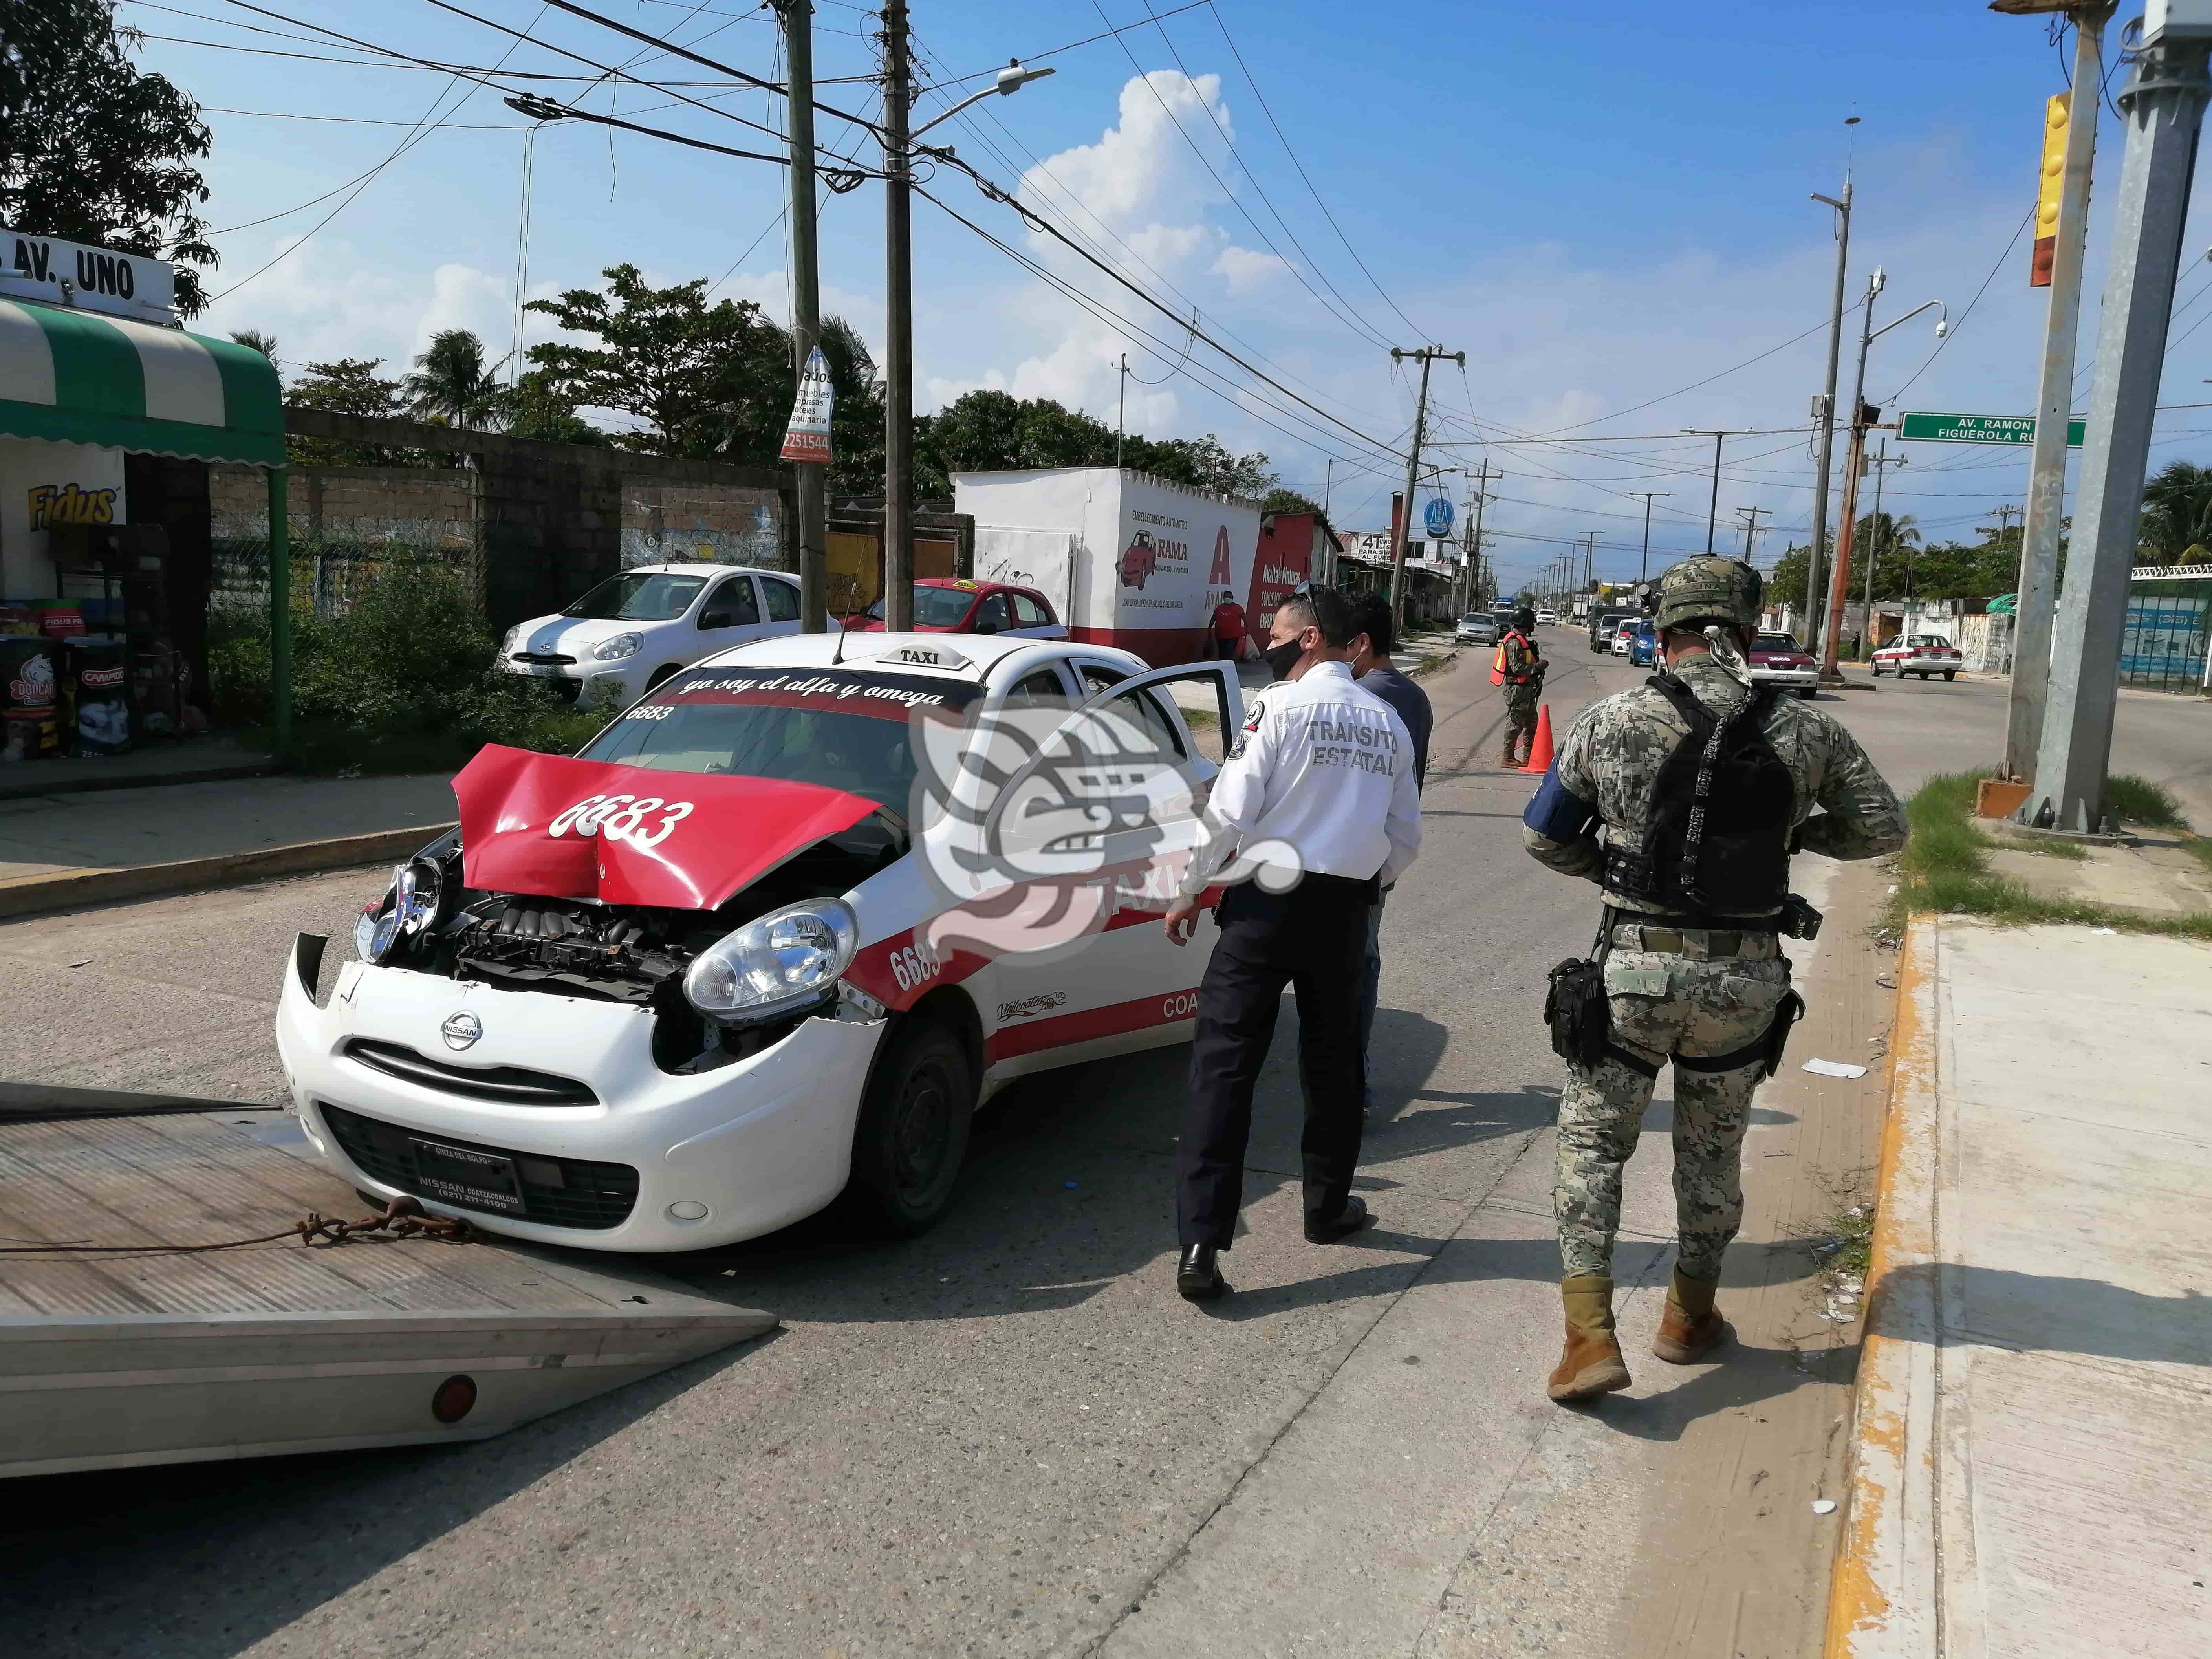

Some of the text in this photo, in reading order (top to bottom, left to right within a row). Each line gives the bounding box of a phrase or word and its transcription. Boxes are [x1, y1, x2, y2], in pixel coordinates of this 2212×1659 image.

[77, 250, 134, 300] UNO
[1938, 429, 2012, 441] FIGUEROLA
[1958, 419, 2031, 430] AV. RAMON
[28, 483, 117, 532] Fidus
[1166, 518, 1188, 530] AUTOMOTRIZ
[1157, 538, 1188, 561] RAMA
[1263, 564, 1278, 584] Axalta
[1282, 566, 1301, 586] Pinturas
[901, 650, 939, 665] TAXI
[679, 675, 944, 707] yo soy el alfa y omega
[626, 705, 674, 720] 6683
[1309, 721, 1397, 754] TRANSITO
[1313, 747, 1394, 777] ESTATAL
[549, 794, 694, 848] 6683
[1087, 864, 1176, 918] TAXI
[890, 938, 940, 991] 6683
[1163, 993, 1198, 1018] COA
[445, 1023, 477, 1038] NISSAN
[435, 1147, 453, 1158] GINZA
[467, 1154, 488, 1164] GOLFO
[420, 1177, 518, 1203] NISSAN COATZACOALCOS
